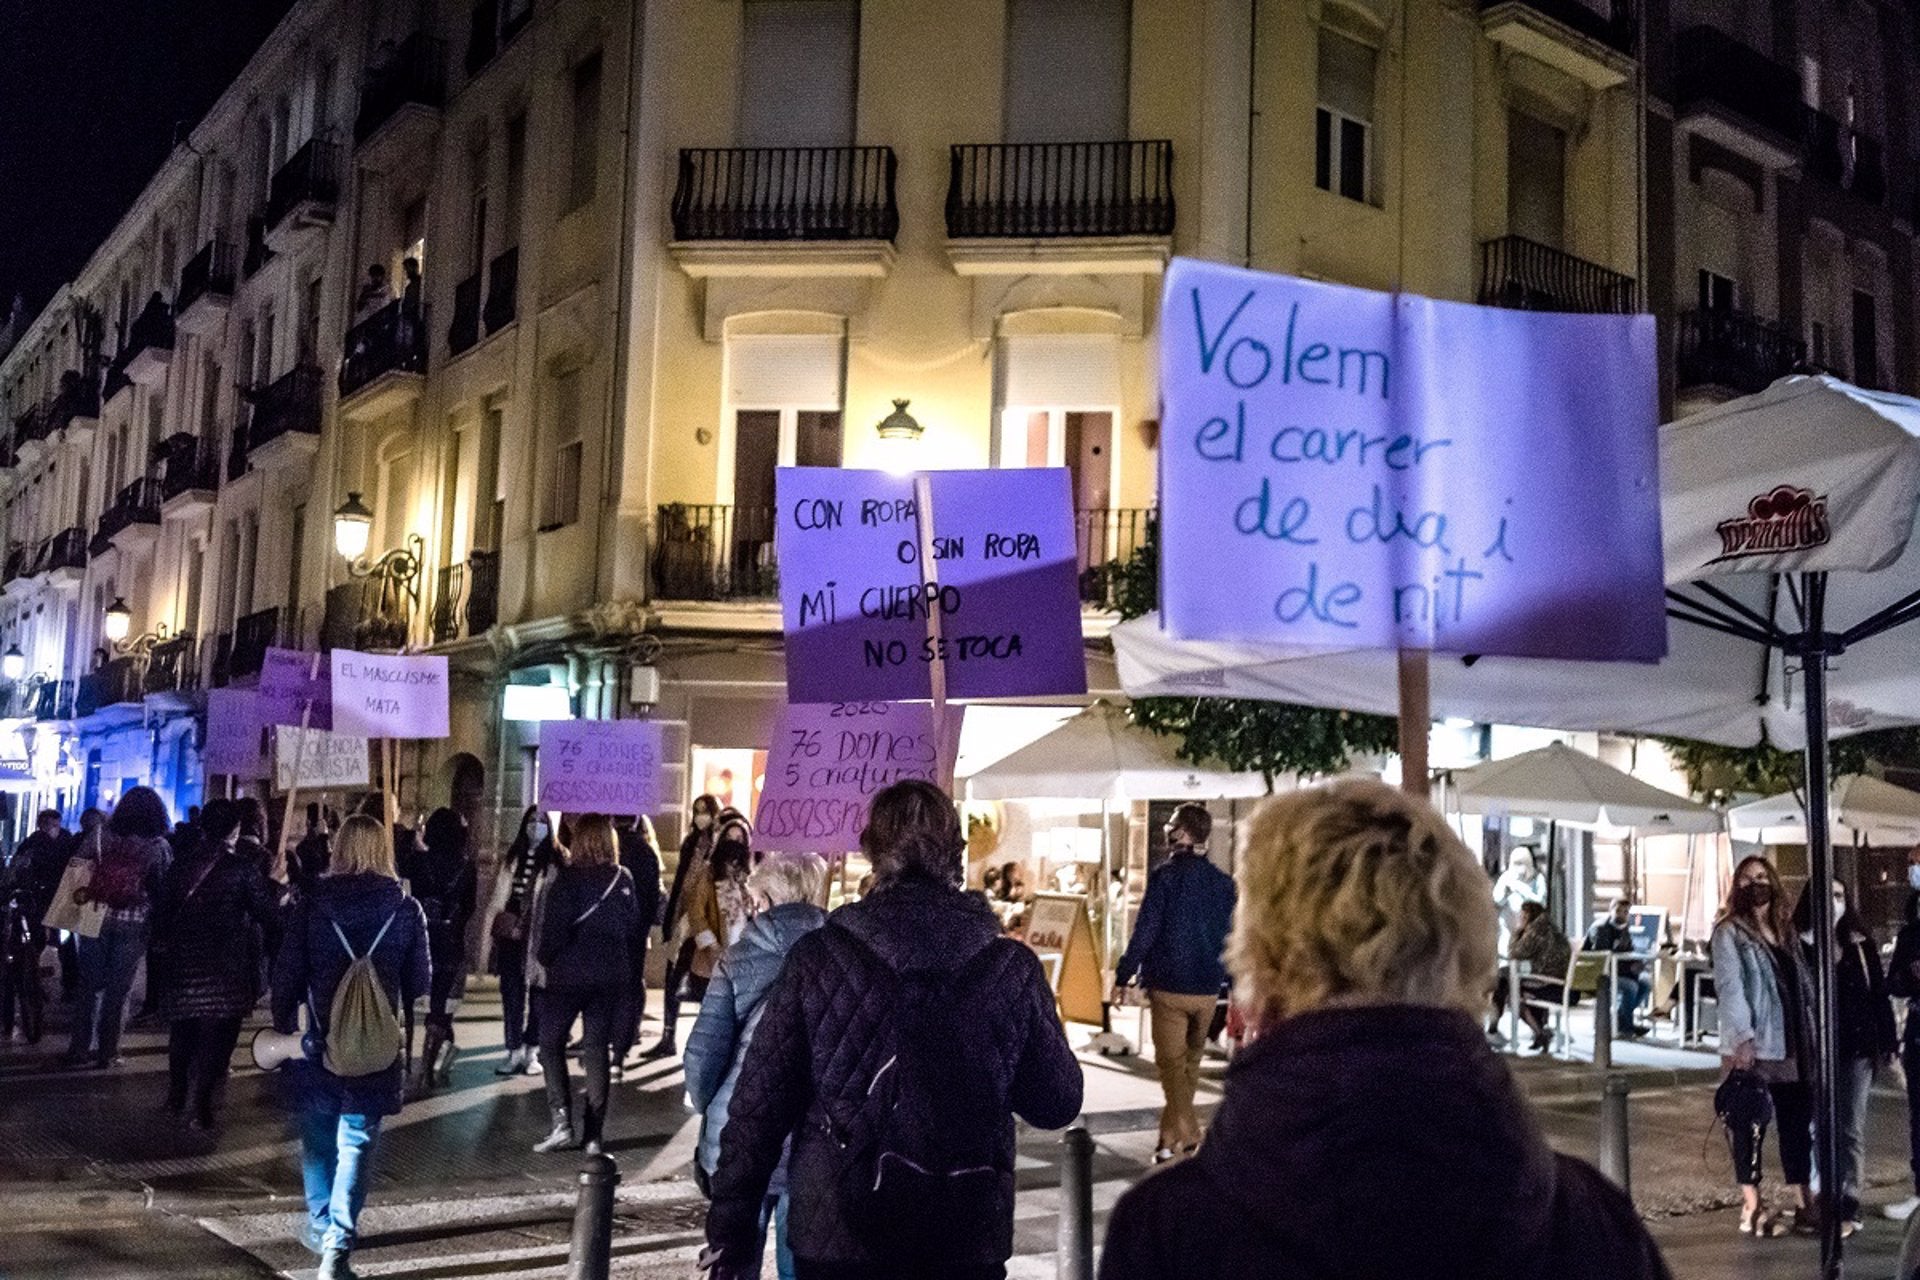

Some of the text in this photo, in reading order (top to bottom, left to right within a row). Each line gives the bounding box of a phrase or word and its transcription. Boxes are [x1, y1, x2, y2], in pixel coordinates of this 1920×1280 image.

[1192, 287, 1389, 400] Volem
[1195, 400, 1452, 471] el carrer
[794, 498, 920, 530] CON ROPA
[1234, 476, 1514, 563] de dia i
[898, 532, 1041, 563] O SIN ROPA
[859, 581, 961, 621] CUERPO
[1274, 557, 1484, 630] de nit
[864, 633, 1024, 669] NO SE TOCA
[341, 662, 357, 678] EL
[363, 666, 441, 685] MASCLISME
[365, 696, 400, 715] MATA
[830, 702, 889, 718] 2020
[557, 739, 582, 756] 76
[790, 730, 821, 758] 76
[561, 759, 575, 774] 5
[785, 763, 799, 788] 5
